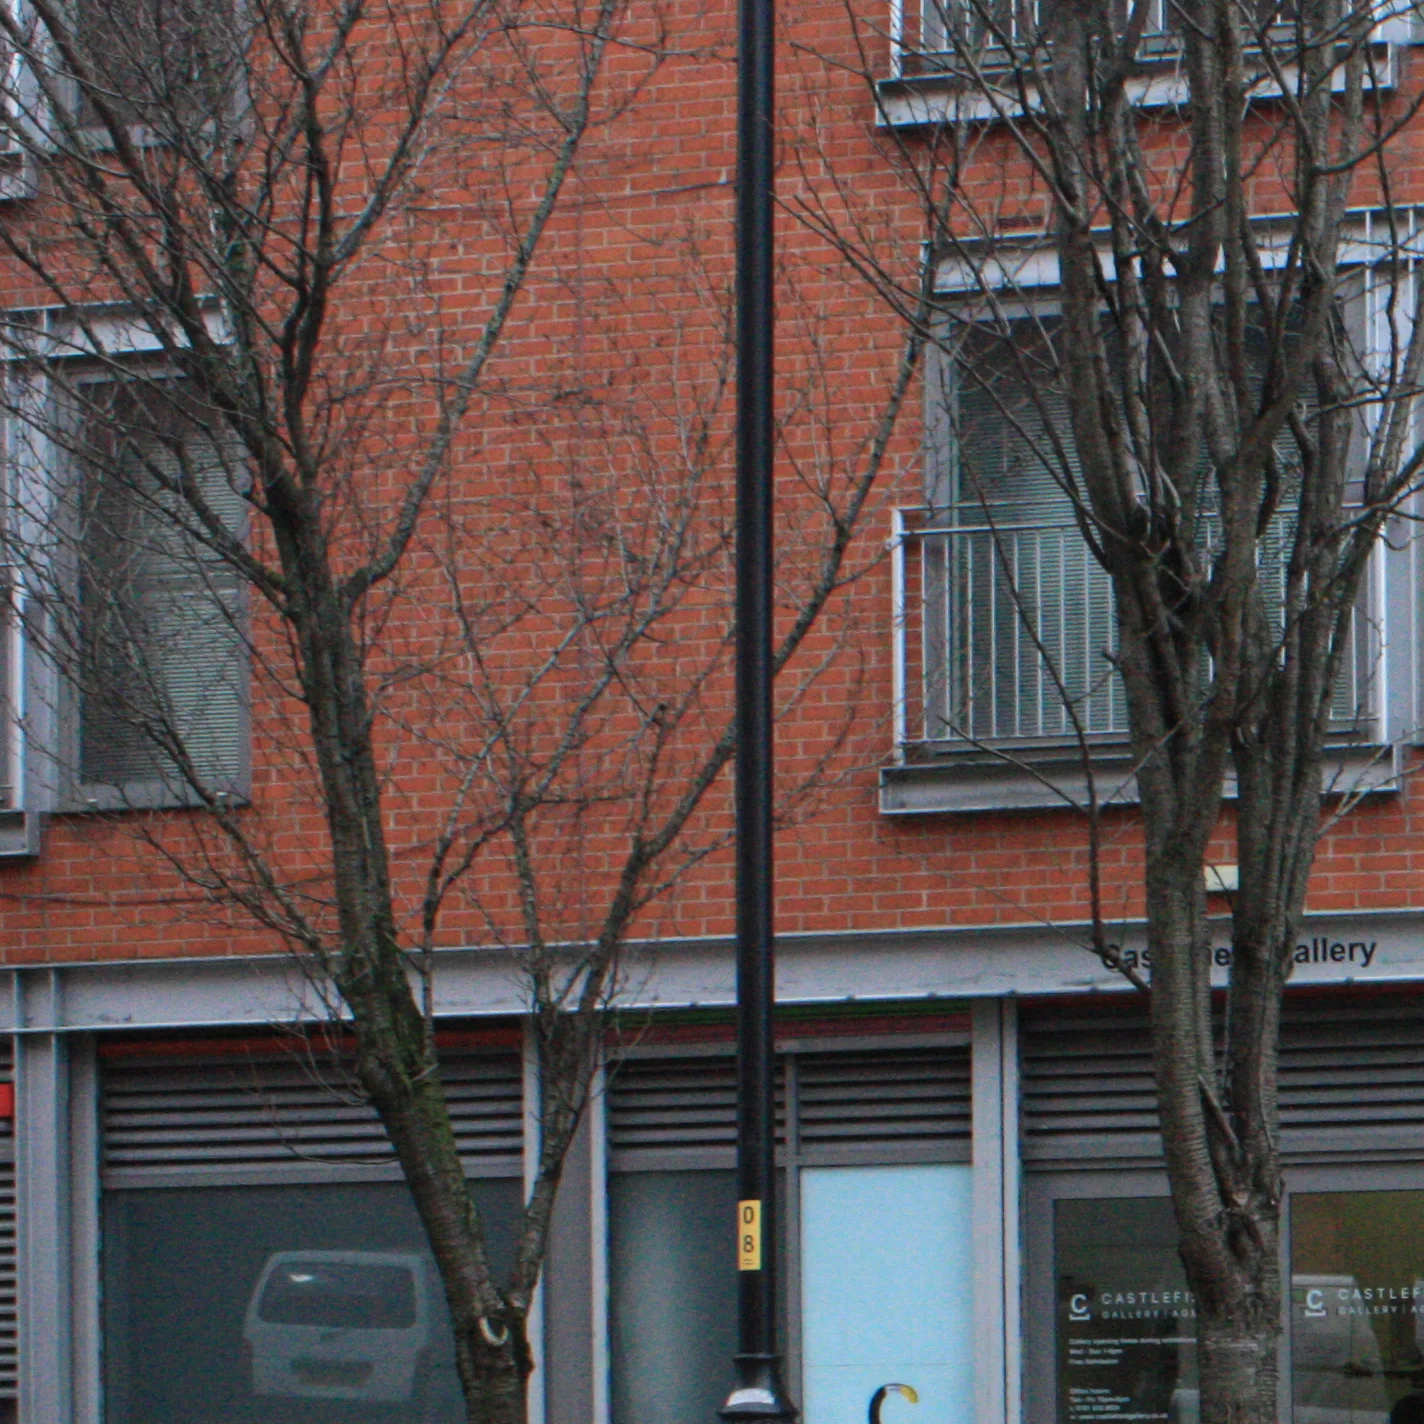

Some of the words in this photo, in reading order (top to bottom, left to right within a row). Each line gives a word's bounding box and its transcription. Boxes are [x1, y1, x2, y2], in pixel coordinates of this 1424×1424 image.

[1293, 937, 1377, 968] allery
[1101, 1290, 1196, 1305] CASTLEFI
[1338, 1305, 1399, 1316] GALLERY
